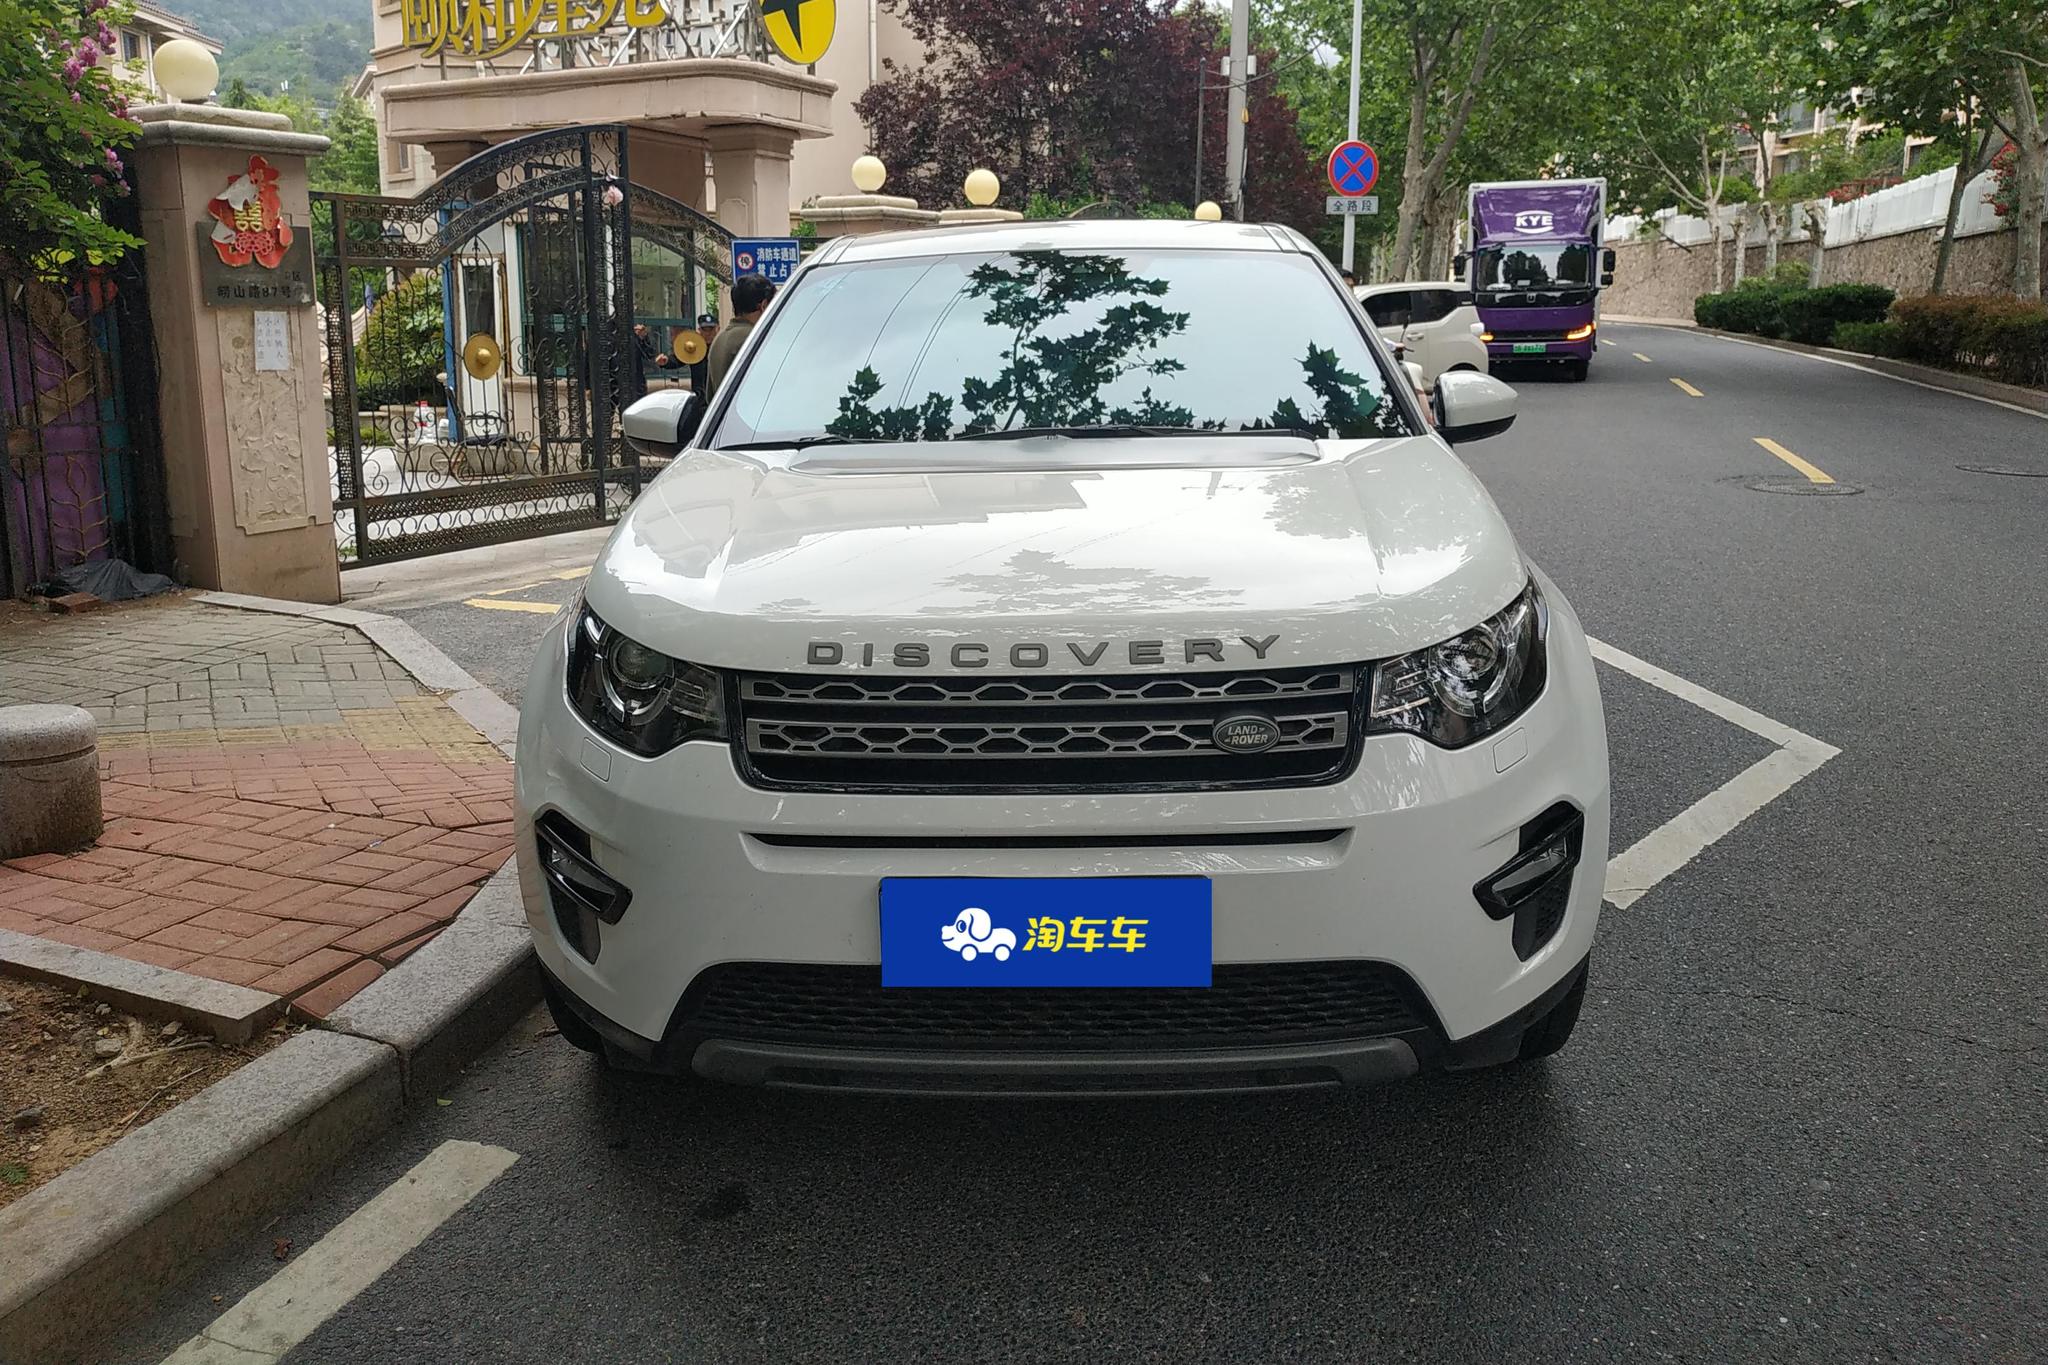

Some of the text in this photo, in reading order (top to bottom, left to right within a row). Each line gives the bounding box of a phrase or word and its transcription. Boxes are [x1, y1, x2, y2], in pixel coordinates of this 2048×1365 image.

[1332, 200, 1373, 212] 全路段
[1515, 214, 1553, 227] KYE
[756, 247, 797, 262] 消防车通道
[807, 633, 1281, 669] DISCOVERY
[1227, 725, 1258, 736] LAND
[1230, 734, 1269, 745] ROVER
